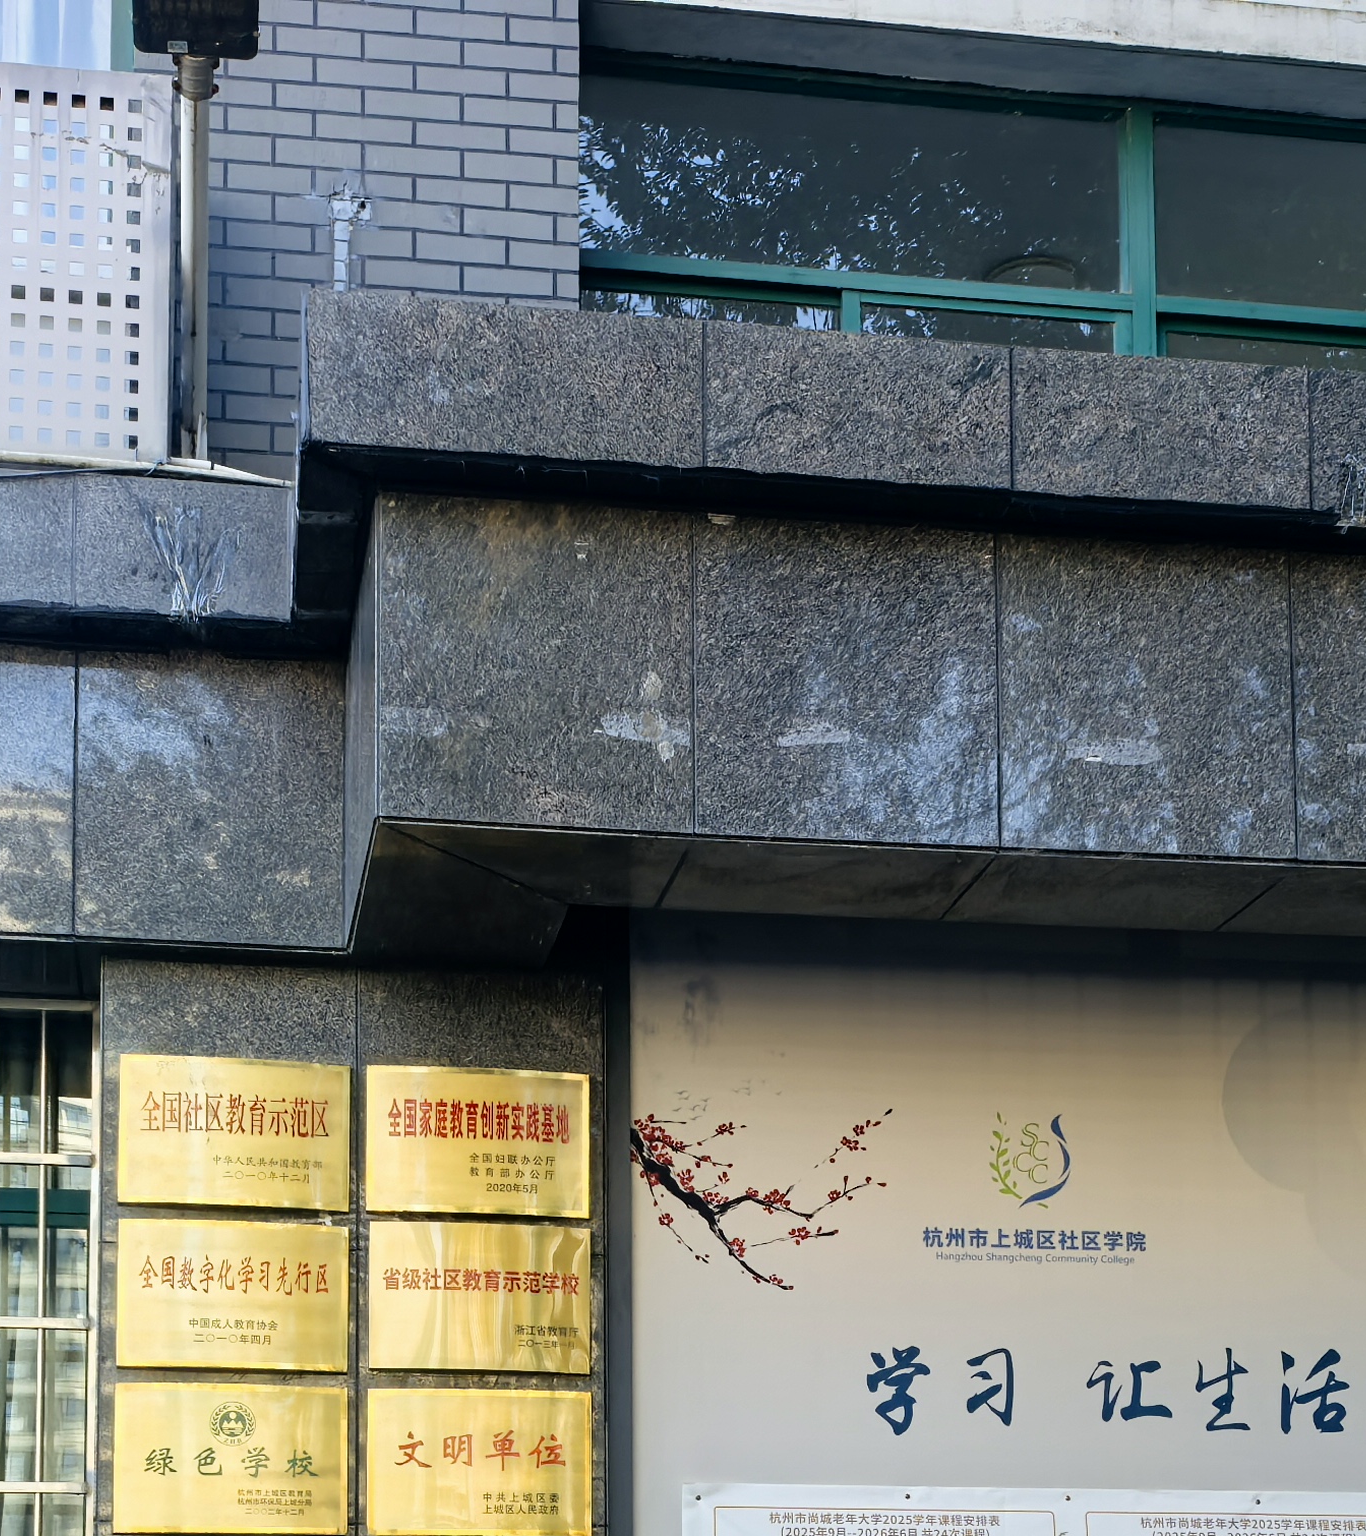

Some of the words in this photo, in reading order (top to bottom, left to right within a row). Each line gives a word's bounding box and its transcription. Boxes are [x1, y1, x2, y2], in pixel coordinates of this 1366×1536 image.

[140, 1091, 329, 1138] 全国社区教育示范区
[387, 1098, 570, 1145] 全国家庭教育创新实践基地
[213, 1155, 322, 1170] 中华人民共和国教育部
[469, 1152, 555, 1166] 全国妇联办公厅
[469, 1167, 554, 1180] 教育部办公厅
[486, 1183, 538, 1194] 2020年5月
[922, 1227, 1146, 1252] 杭州市上城区社区学院
[936, 1252, 983, 1264] Hangzhou
[986, 1253, 1042, 1265] Shangcheng
[1045, 1254, 1098, 1266] Community
[1101, 1255, 1135, 1266] College
[139, 1255, 330, 1297] 全国数字化学习先行区
[382, 1267, 580, 1297] 省级社区教育示范学校
[189, 1318, 278, 1330] 中国成人教育协会
[866, 1347, 1018, 1435] 学习
[394, 1431, 567, 1471] 文明单位
[143, 1447, 320, 1478] 绿色学校
[482, 1504, 559, 1515] 上城区人民政府
[769, 1513, 1001, 1527] 杭州市尚城老年大学2025学年课程安排表
[1141, 1517, 1366, 1531] 杭州市尚城老年大学2025学年课程安排表
